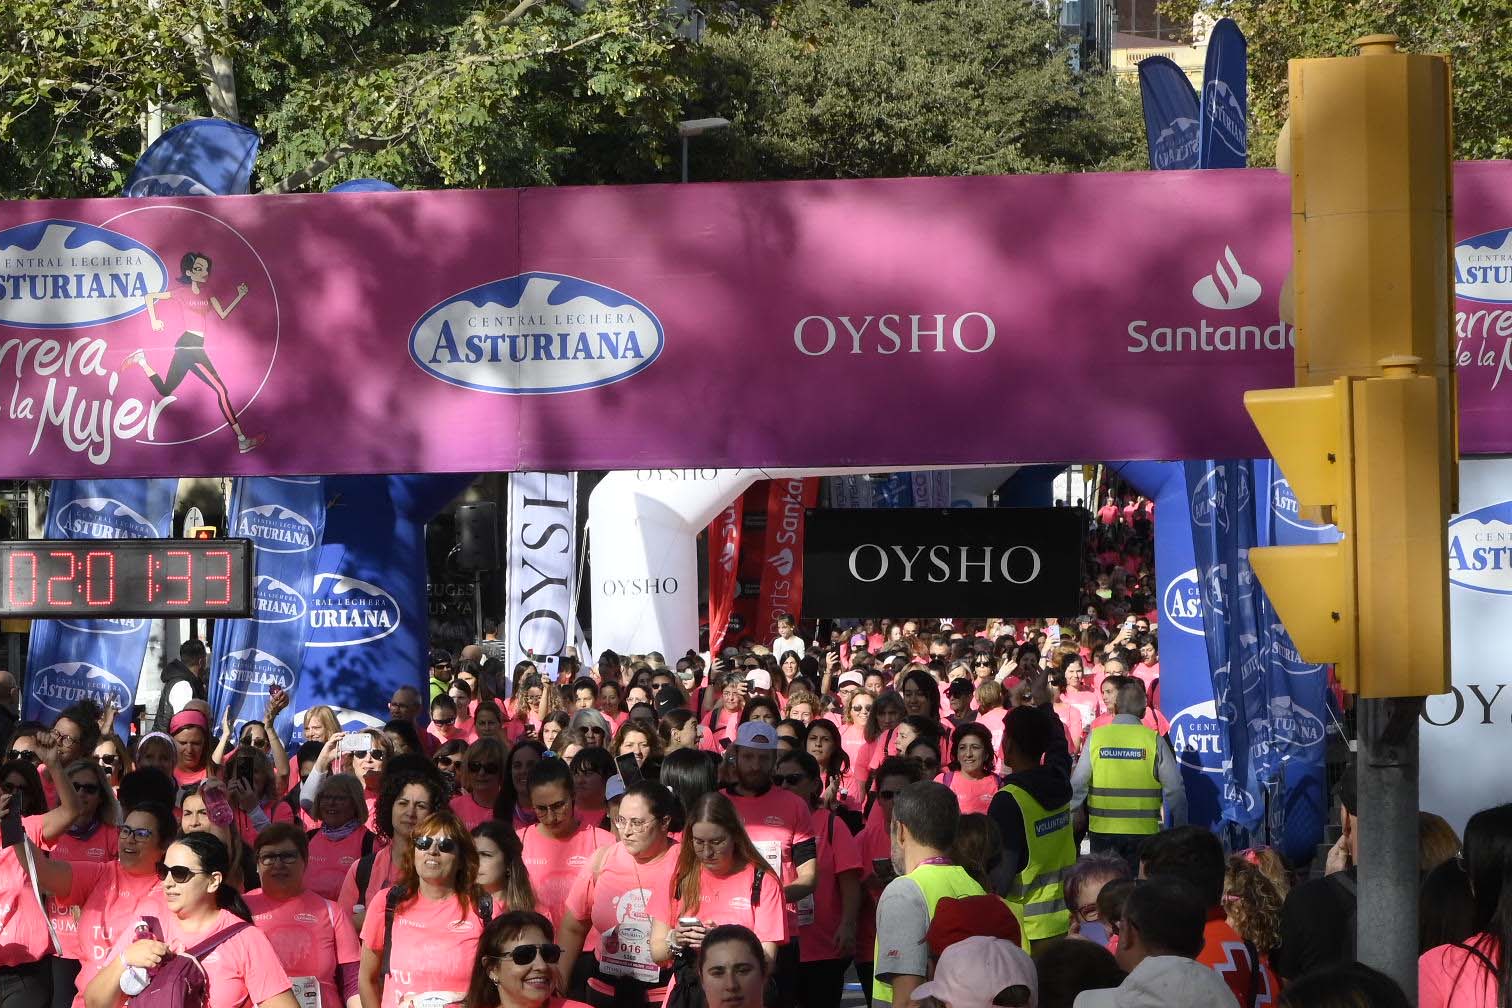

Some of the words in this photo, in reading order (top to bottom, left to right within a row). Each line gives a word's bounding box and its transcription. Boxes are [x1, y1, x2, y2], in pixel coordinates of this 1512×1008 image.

[71, 255, 143, 267] LECHERA
[468, 315, 546, 328] CENTRAL
[555, 313, 635, 325] LECHERA
[428, 320, 644, 364] ASTURIANA
[793, 312, 996, 356] OYSHO
[9, 379, 34, 420] la
[29, 372, 178, 465] Mujer
[239, 521, 310, 547] ASTURIANA
[848, 543, 1041, 584] OYSHO
[8, 550, 233, 606] 02:01:33
[603, 576, 679, 596] OYSHO
[1100, 749, 1141, 757] VOLUNTARIS
[93, 925, 113, 940] TU
[621, 944, 641, 953] 016
